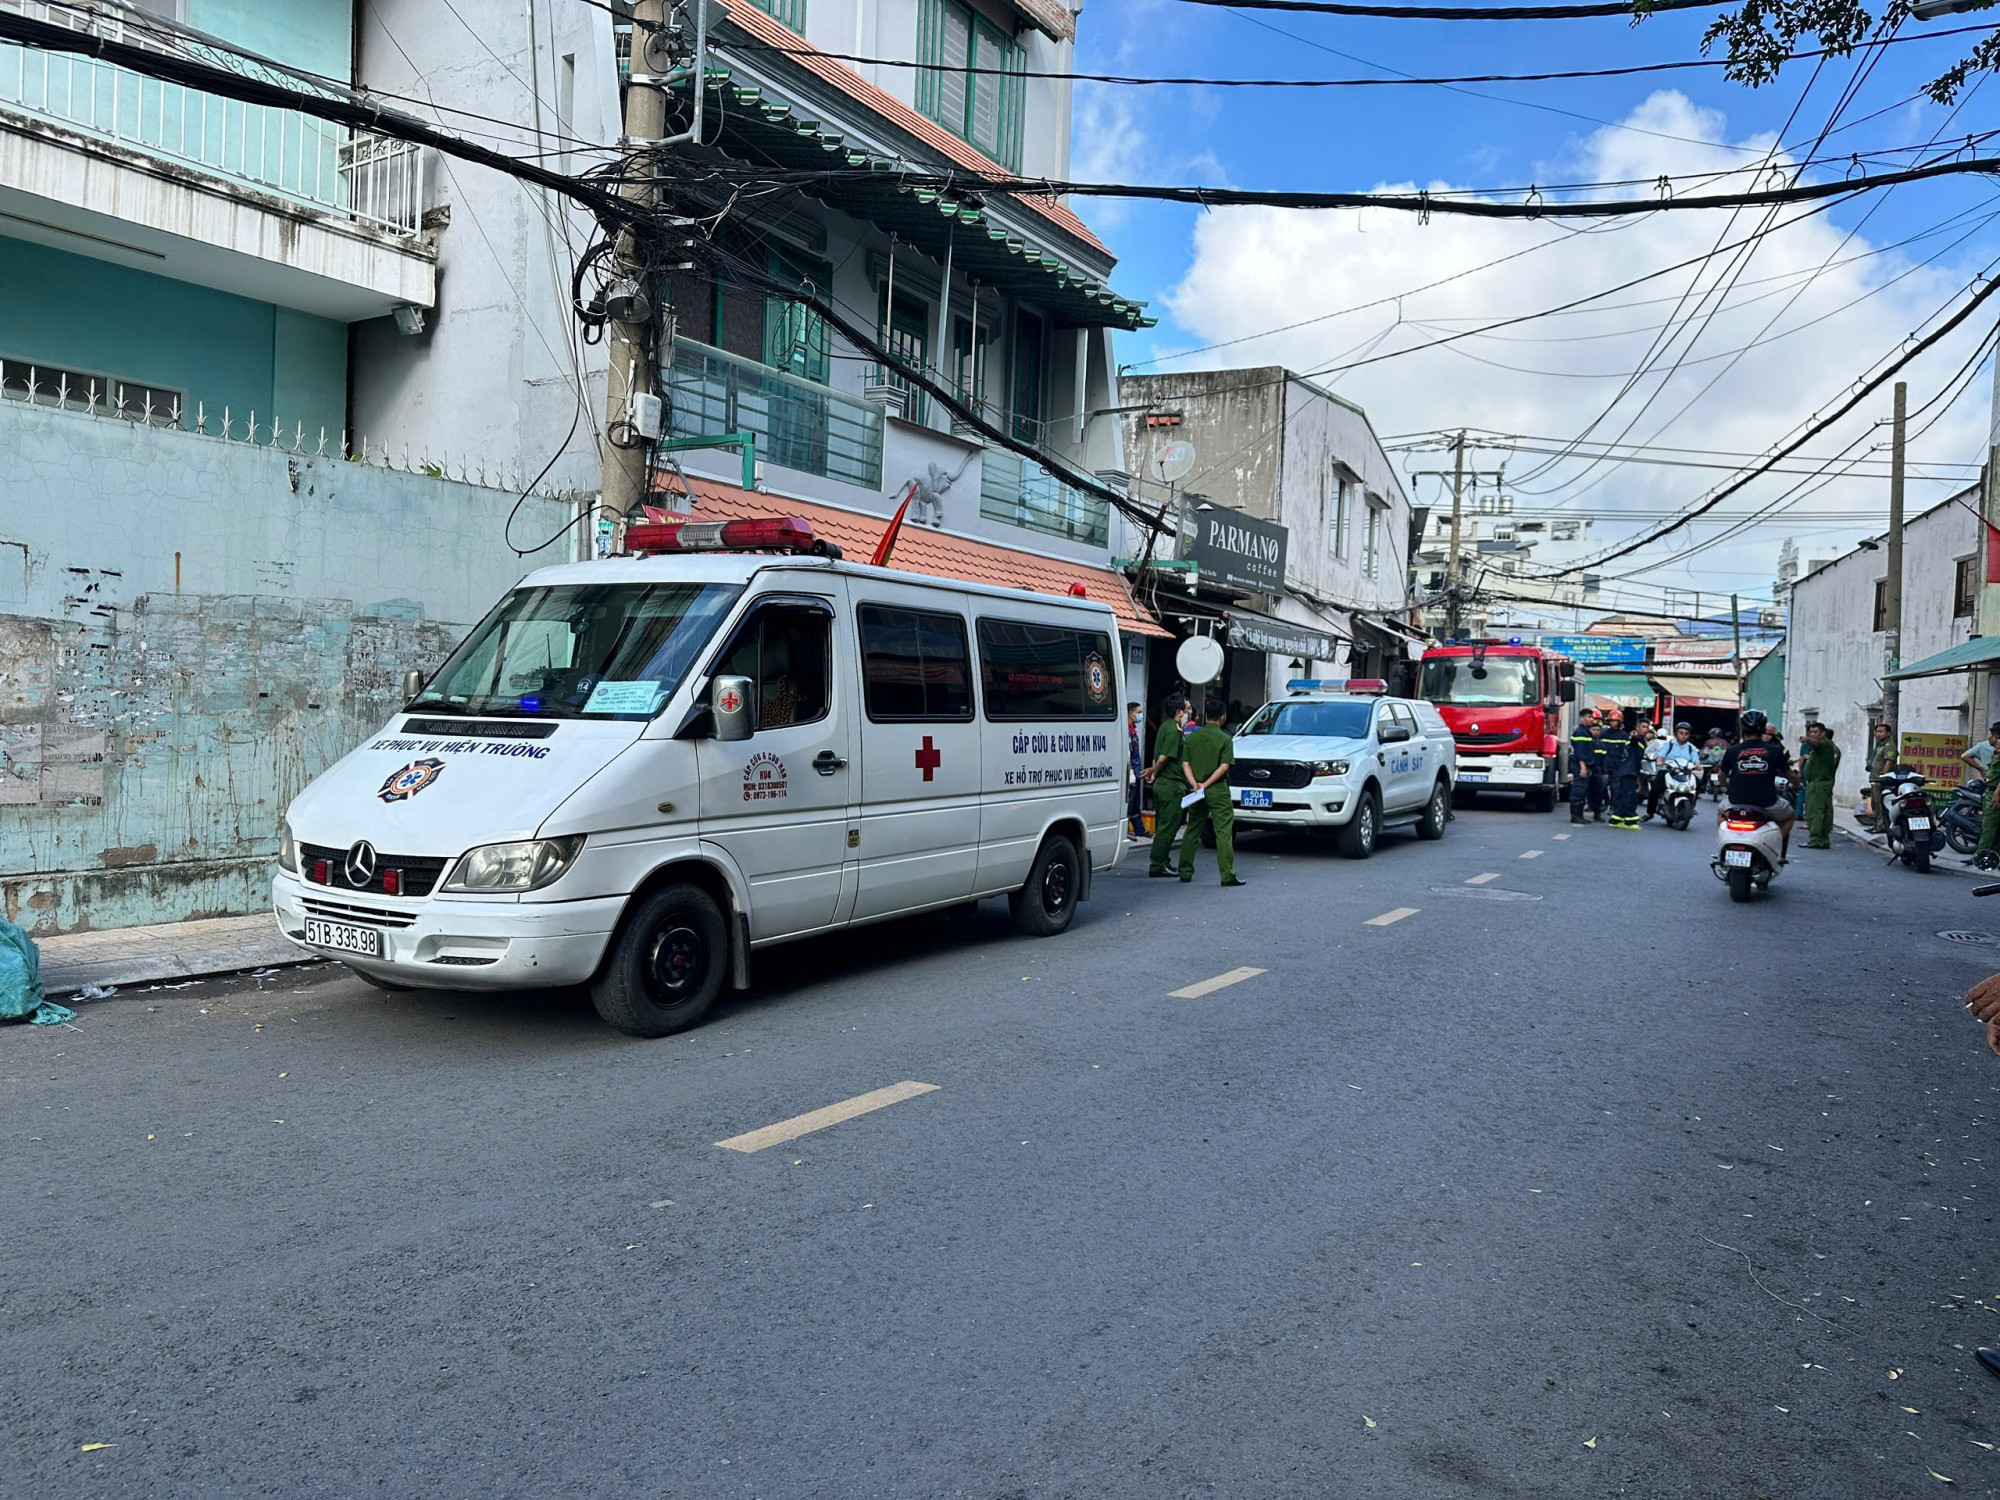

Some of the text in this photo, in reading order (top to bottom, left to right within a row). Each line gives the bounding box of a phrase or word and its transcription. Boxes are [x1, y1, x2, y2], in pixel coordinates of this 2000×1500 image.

[1246, 563, 1277, 578] coffee
[368, 740, 551, 759] XE PHỤC VỤ HIỆN TRƯỜNG
[1012, 728, 1106, 756] CẤP CỨU & CỨU NẠN KV4
[1004, 763, 1112, 785] XE HỖ TRỢ PHỤC VỤ HIỆN TRƯỜNG
[308, 922, 376, 953] 51B-335.98
